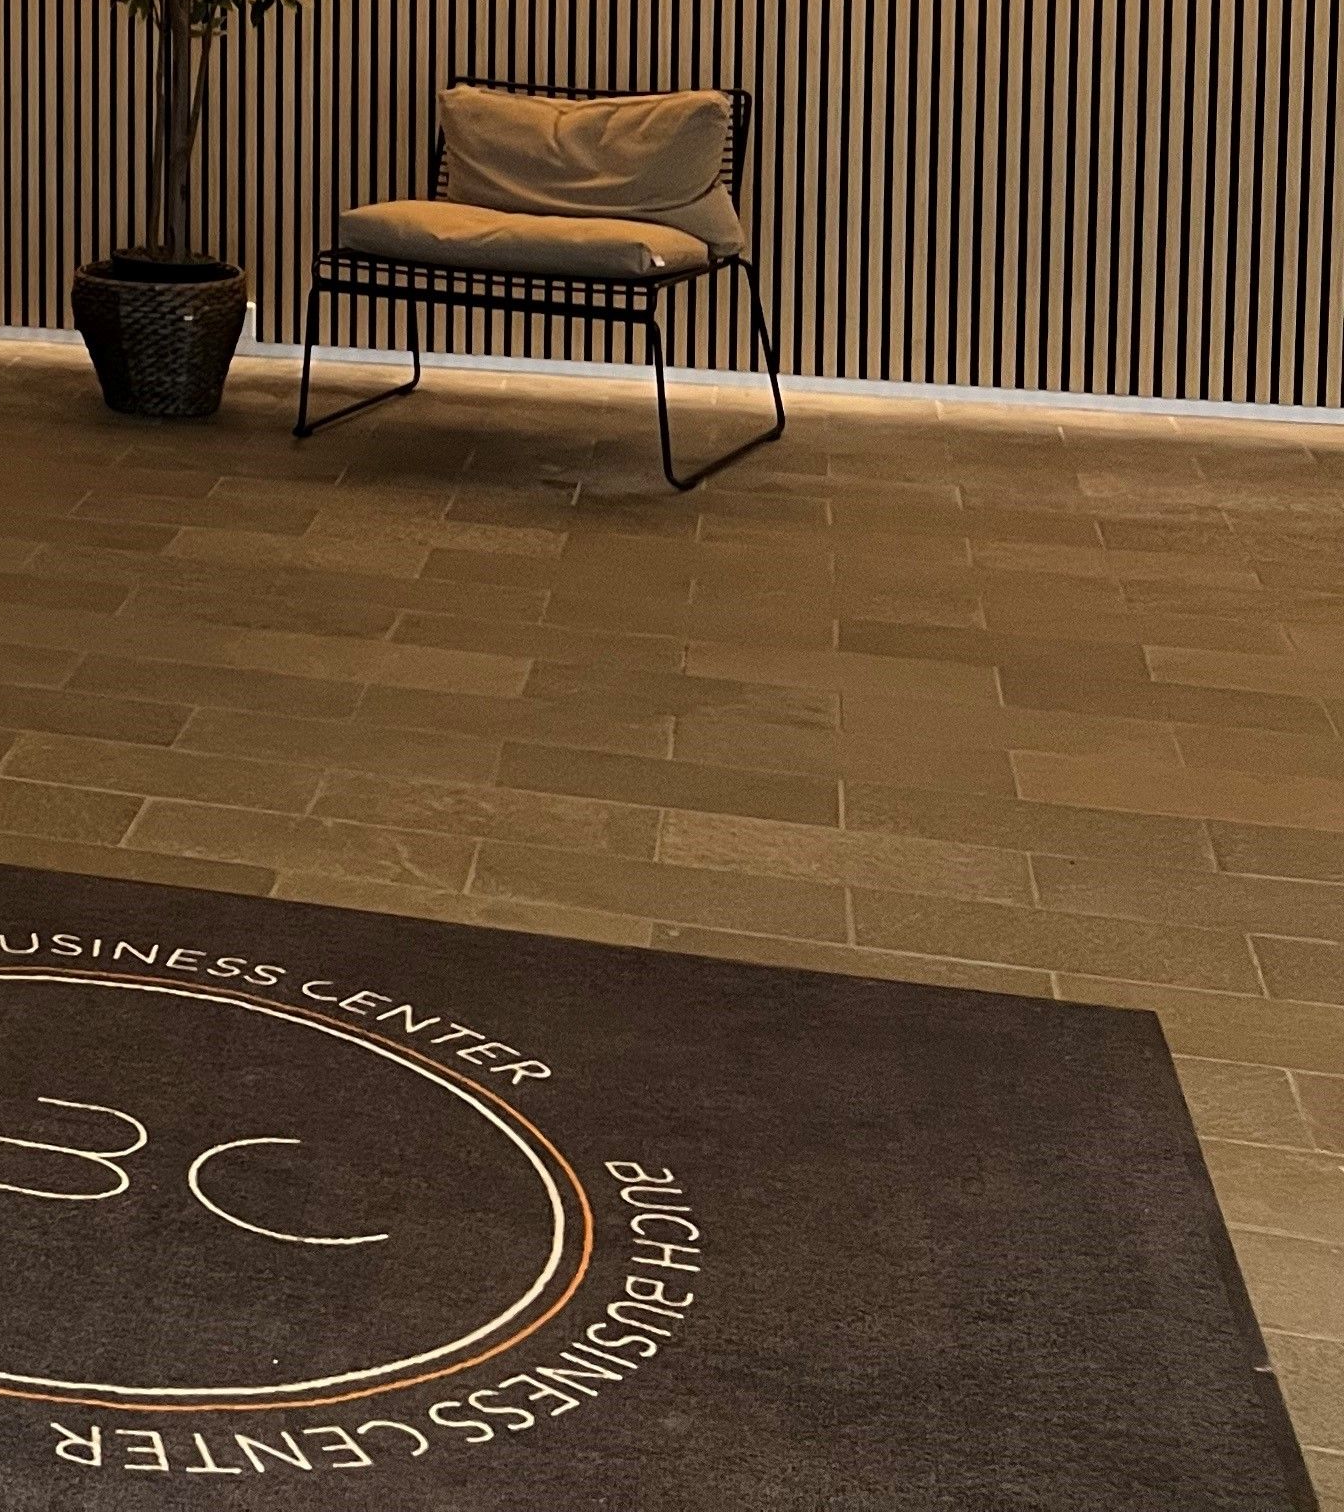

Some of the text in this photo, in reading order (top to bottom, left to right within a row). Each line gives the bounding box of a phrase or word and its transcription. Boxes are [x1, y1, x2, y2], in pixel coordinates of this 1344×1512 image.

[300, 978, 553, 1086] CENTER
[49, 1160, 702, 1476] BUCH BUSINESS CENTER
